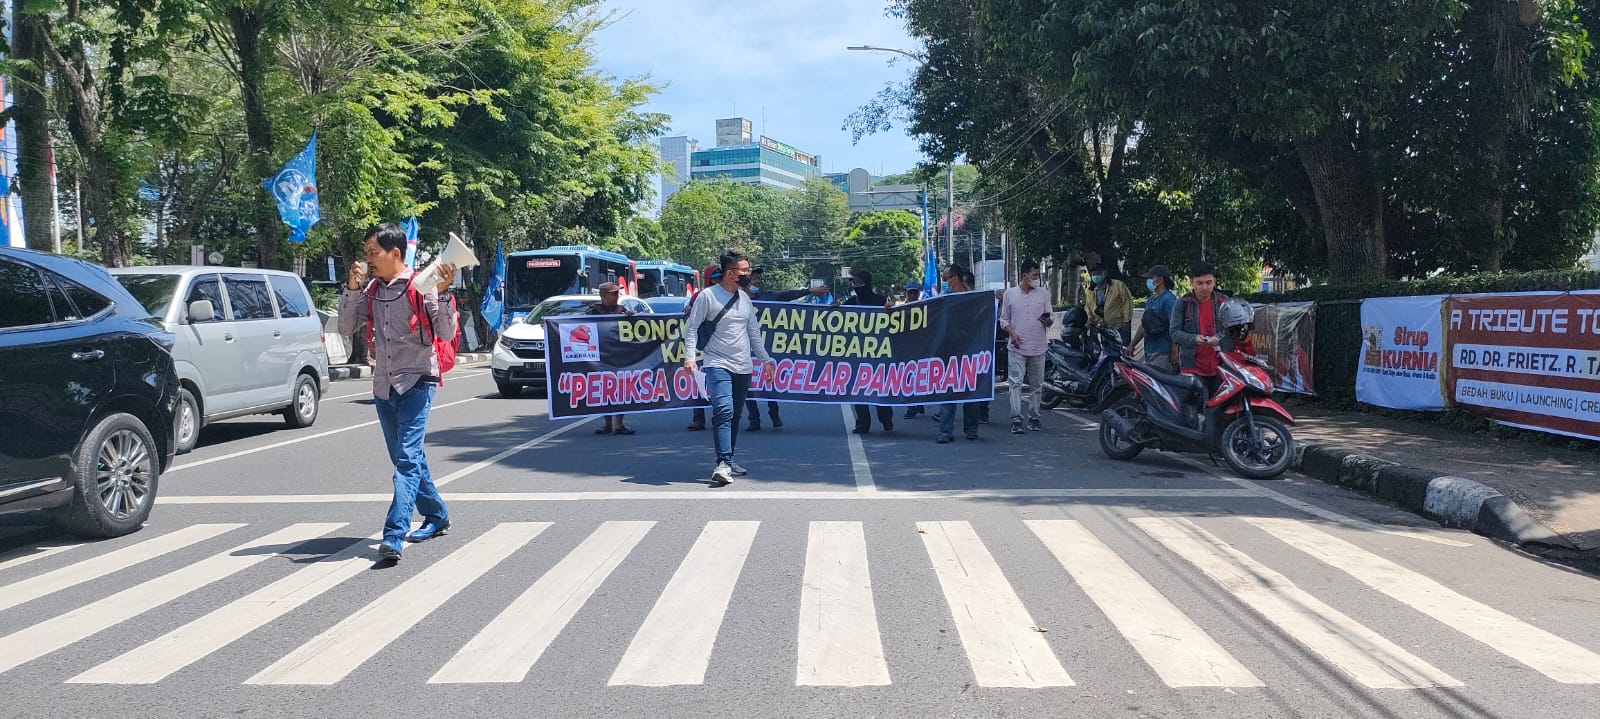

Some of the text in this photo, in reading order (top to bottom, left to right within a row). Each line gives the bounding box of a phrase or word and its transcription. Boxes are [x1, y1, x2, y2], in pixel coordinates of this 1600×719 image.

[812, 309, 905, 334] KORUPSI
[910, 305, 927, 331] DI
[1450, 309, 1463, 330] A
[1468, 309, 1569, 334] TRIBUTE
[772, 332, 892, 358] BATUBARA
[1394, 327, 1429, 350] Sirup
[1382, 350, 1438, 372] KURNIA
[1460, 349, 1479, 366] RD.
[1482, 350, 1504, 368] DR.
[1507, 352, 1562, 373] FRIETZ.
[1461, 386, 1488, 399] BEDAH
[1490, 389, 1514, 402] BUKU
[1521, 394, 1573, 410] LAUNCHING
